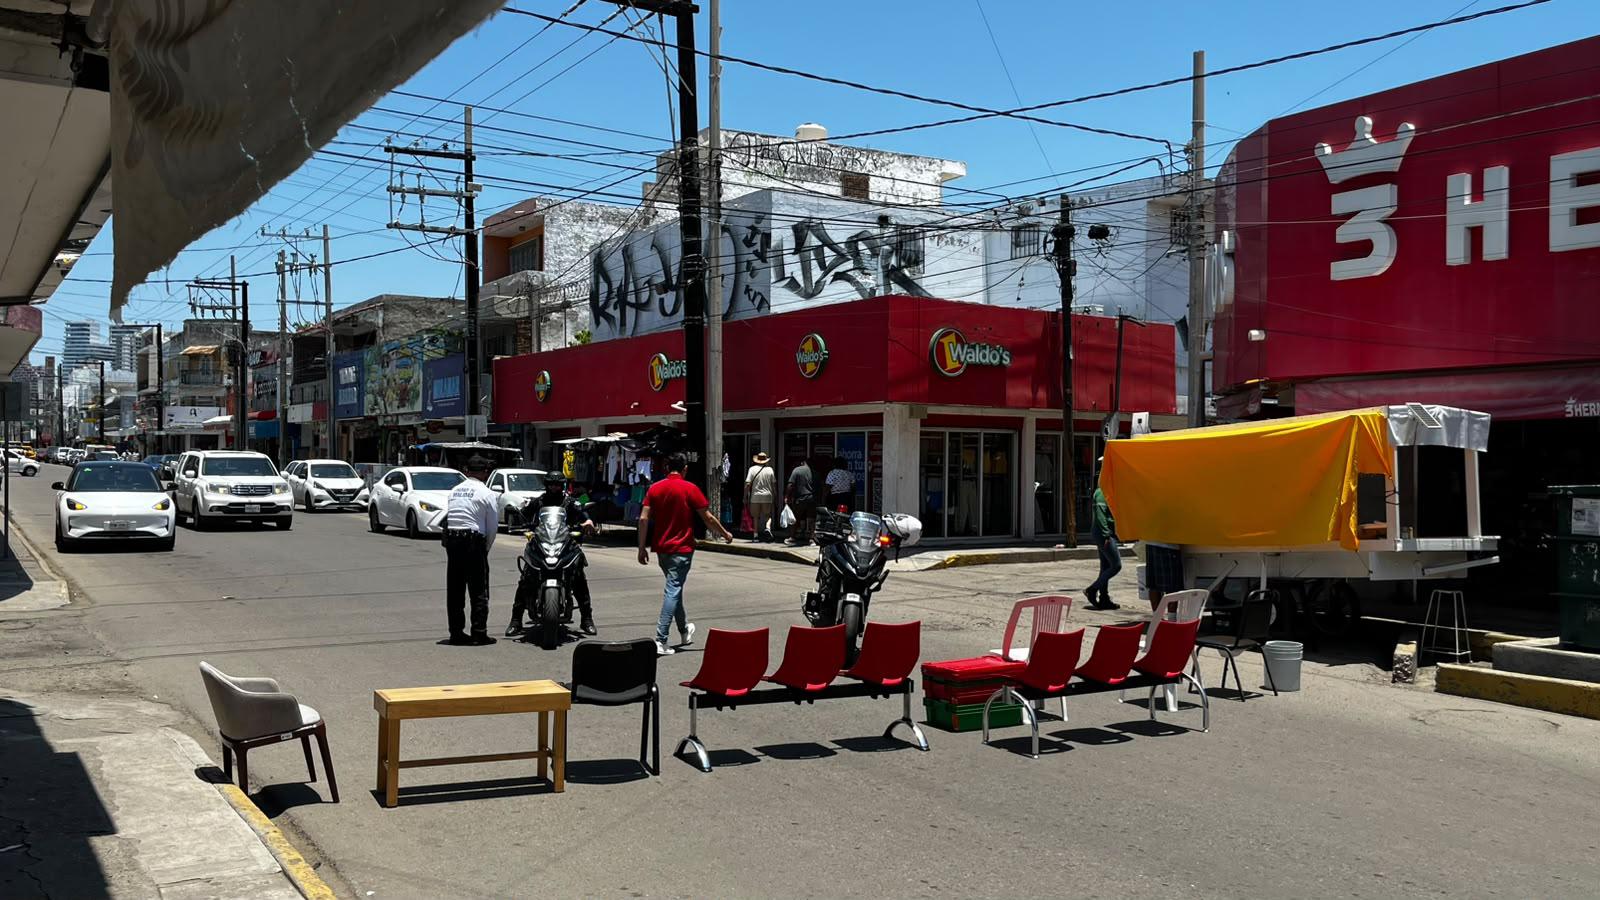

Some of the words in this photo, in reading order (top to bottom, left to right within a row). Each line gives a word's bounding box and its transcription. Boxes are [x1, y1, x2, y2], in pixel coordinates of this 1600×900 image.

[796, 351, 824, 363] Waldo's
[950, 342, 1010, 364] Waldo's
[656, 360, 688, 379] Waldo's
